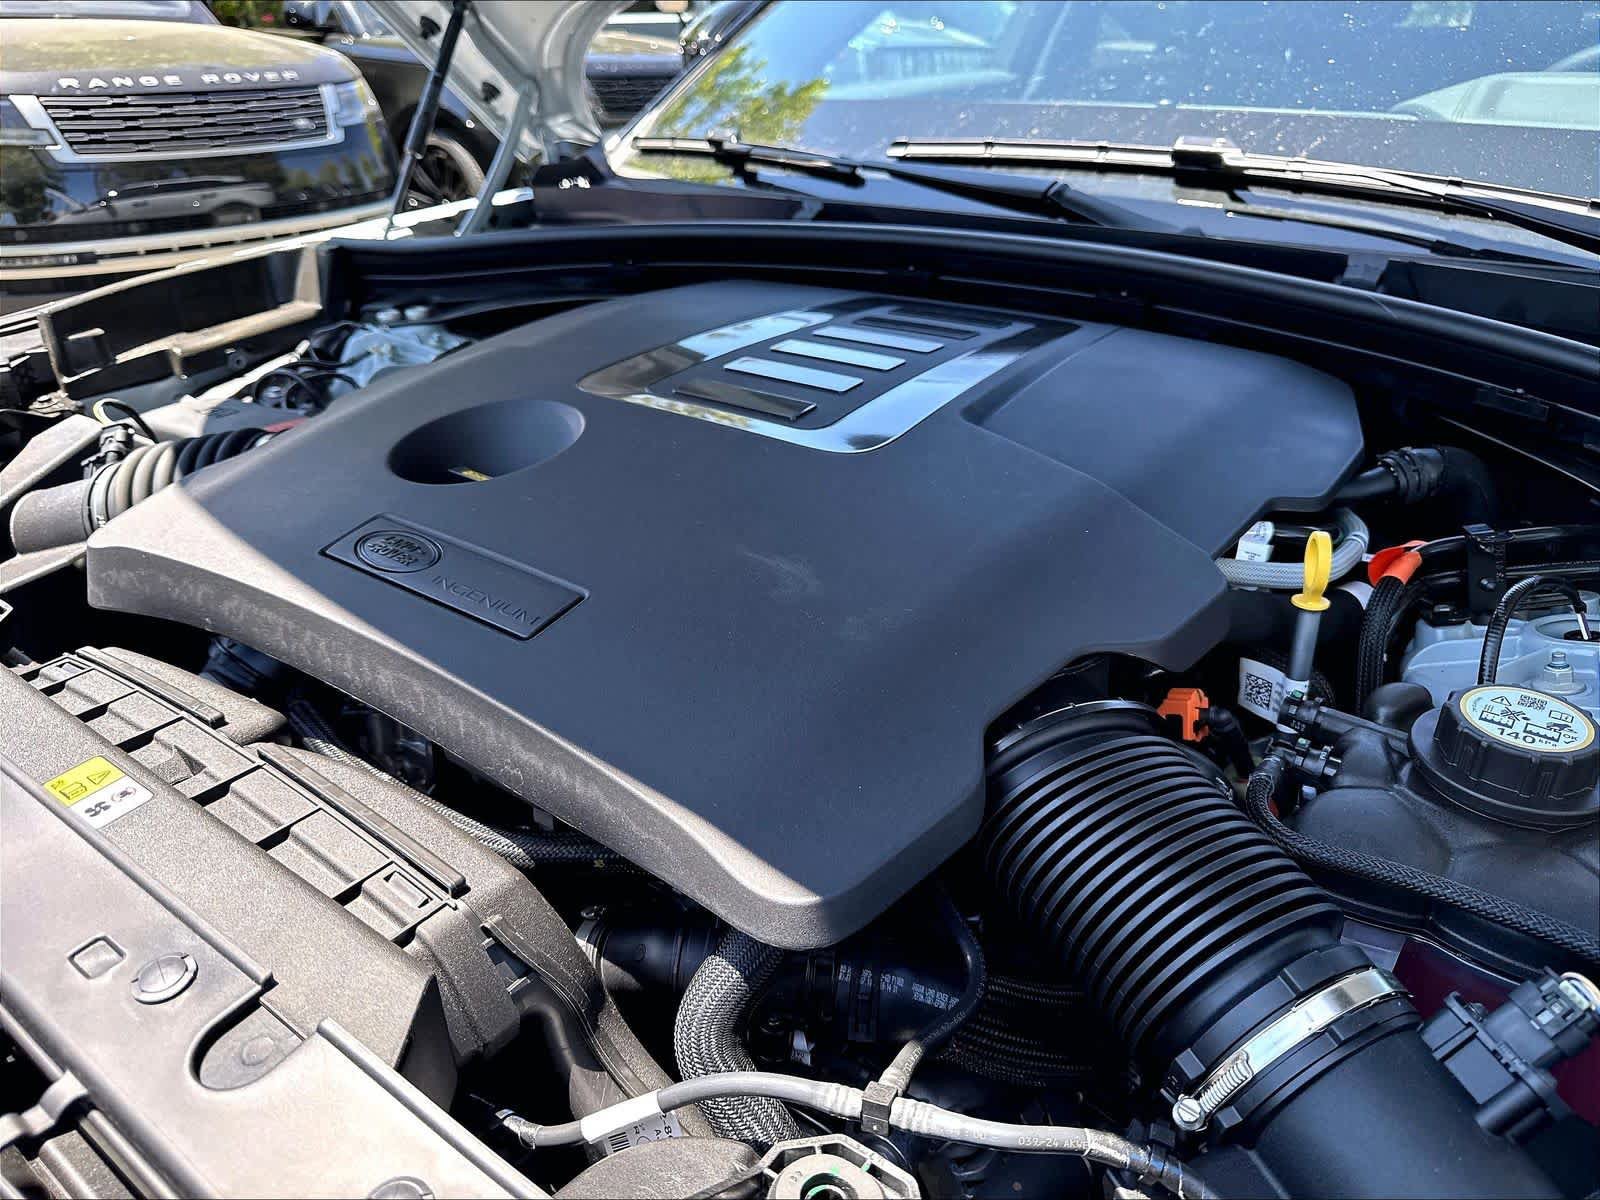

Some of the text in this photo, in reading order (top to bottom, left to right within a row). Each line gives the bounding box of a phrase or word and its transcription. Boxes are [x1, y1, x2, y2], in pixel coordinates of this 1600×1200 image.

[57, 70, 300, 90] RANGE ROVER
[431, 575, 542, 625] INGENIUM
[1497, 727, 1536, 744] 140
[1562, 733, 1579, 742] OK
